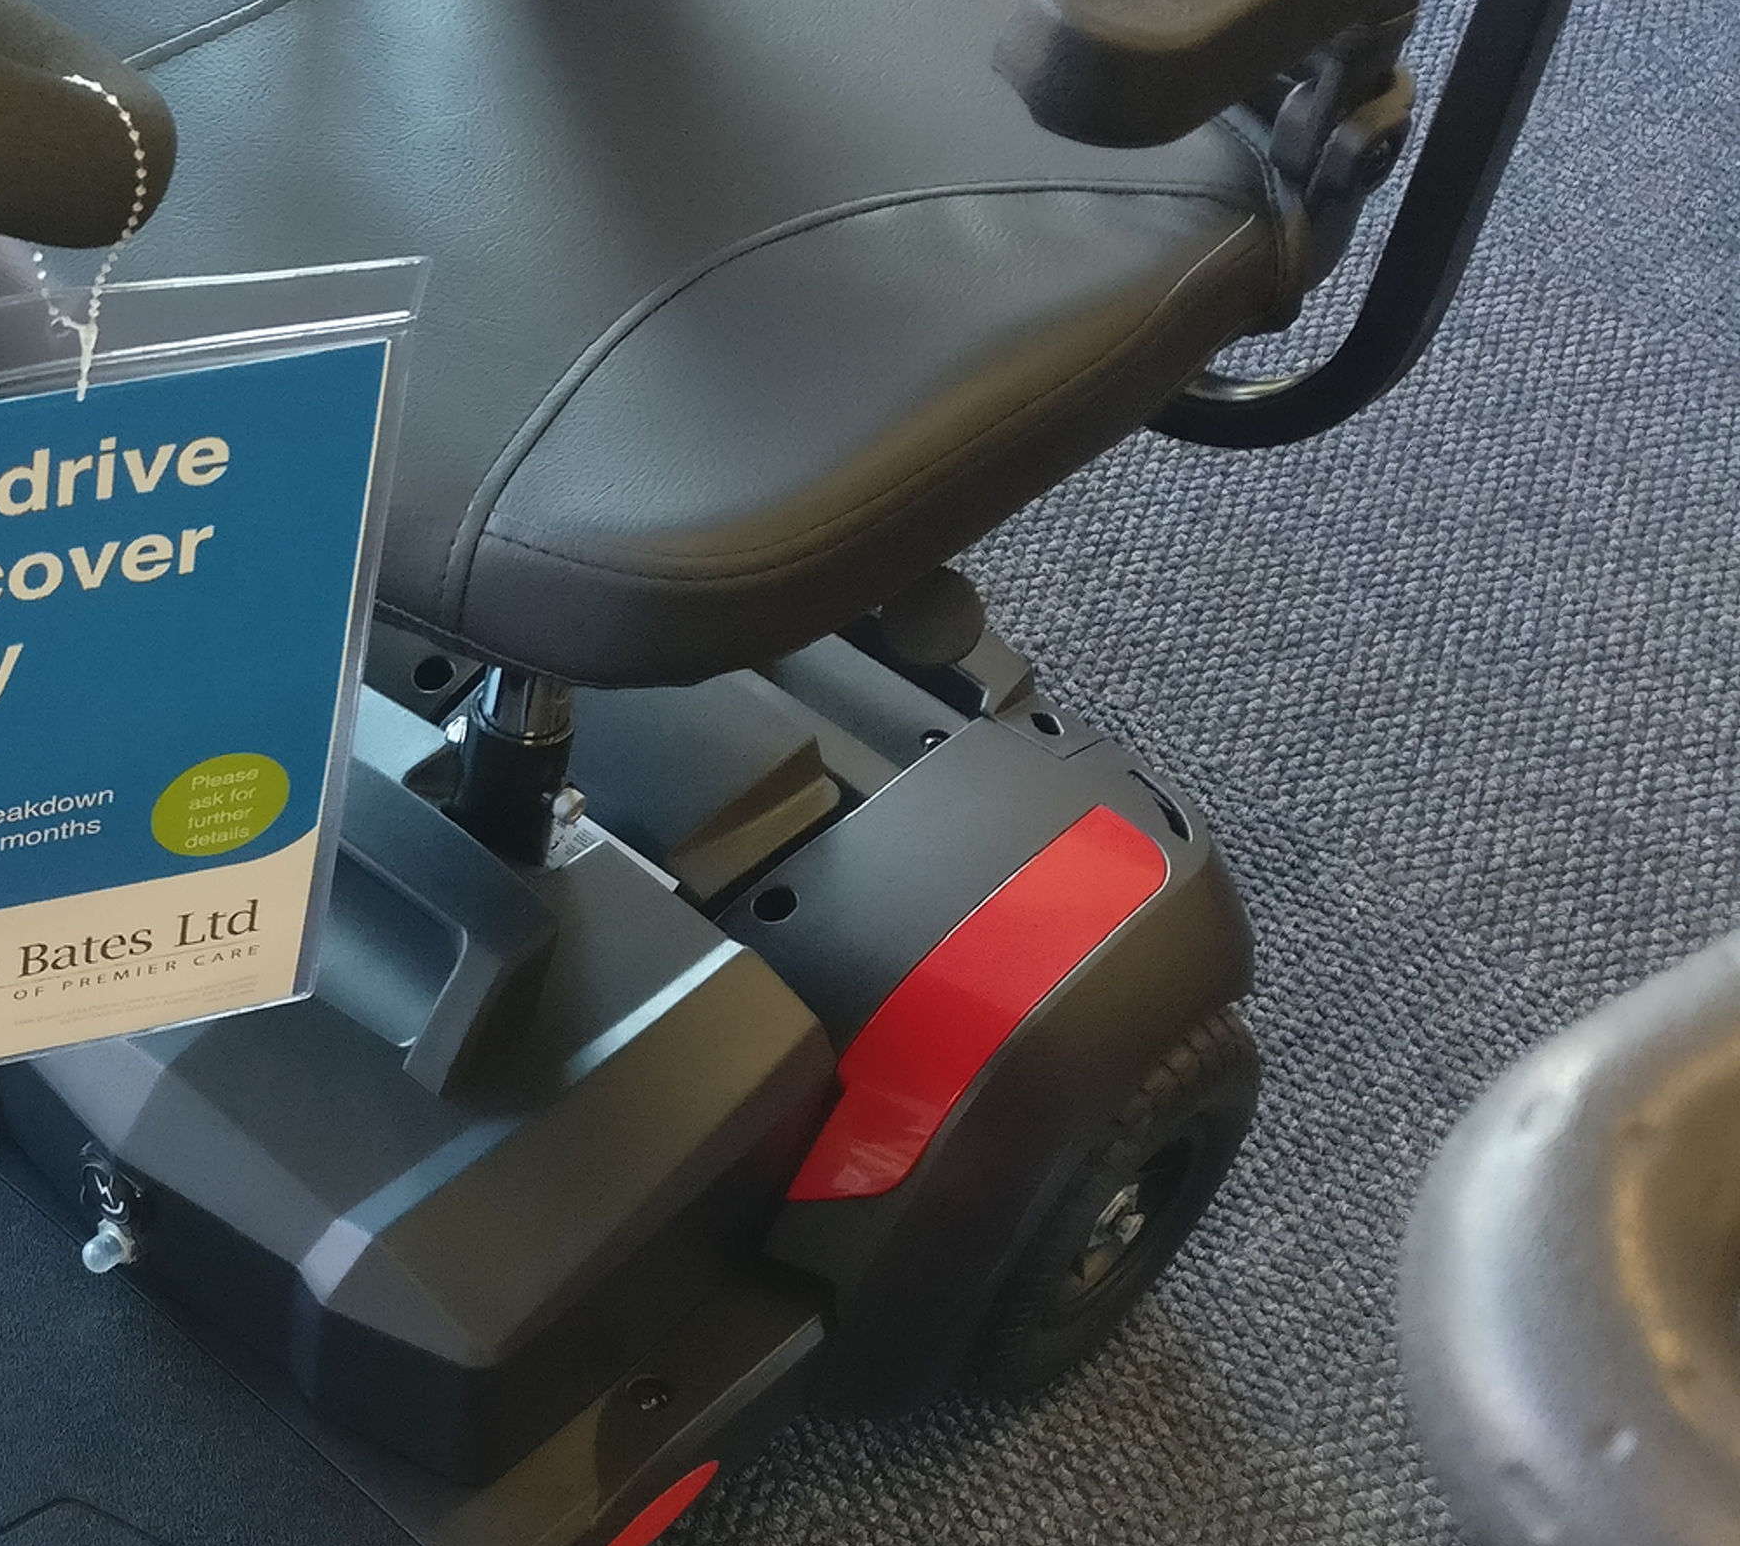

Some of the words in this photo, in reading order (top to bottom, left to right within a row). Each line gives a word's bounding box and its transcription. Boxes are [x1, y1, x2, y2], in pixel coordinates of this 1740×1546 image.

[190, 768, 259, 791] Please
[188, 791, 225, 811] ask
[230, 787, 257, 803] for
[187, 807, 254, 830] further
[0, 818, 102, 852] months
[184, 826, 251, 849] details
[16, 928, 153, 979] Bates
[173, 898, 259, 948] Ltd
[13, 986, 45, 1001] OF
[61, 960, 177, 992] PREMIER
[192, 943, 260, 967] CARE
